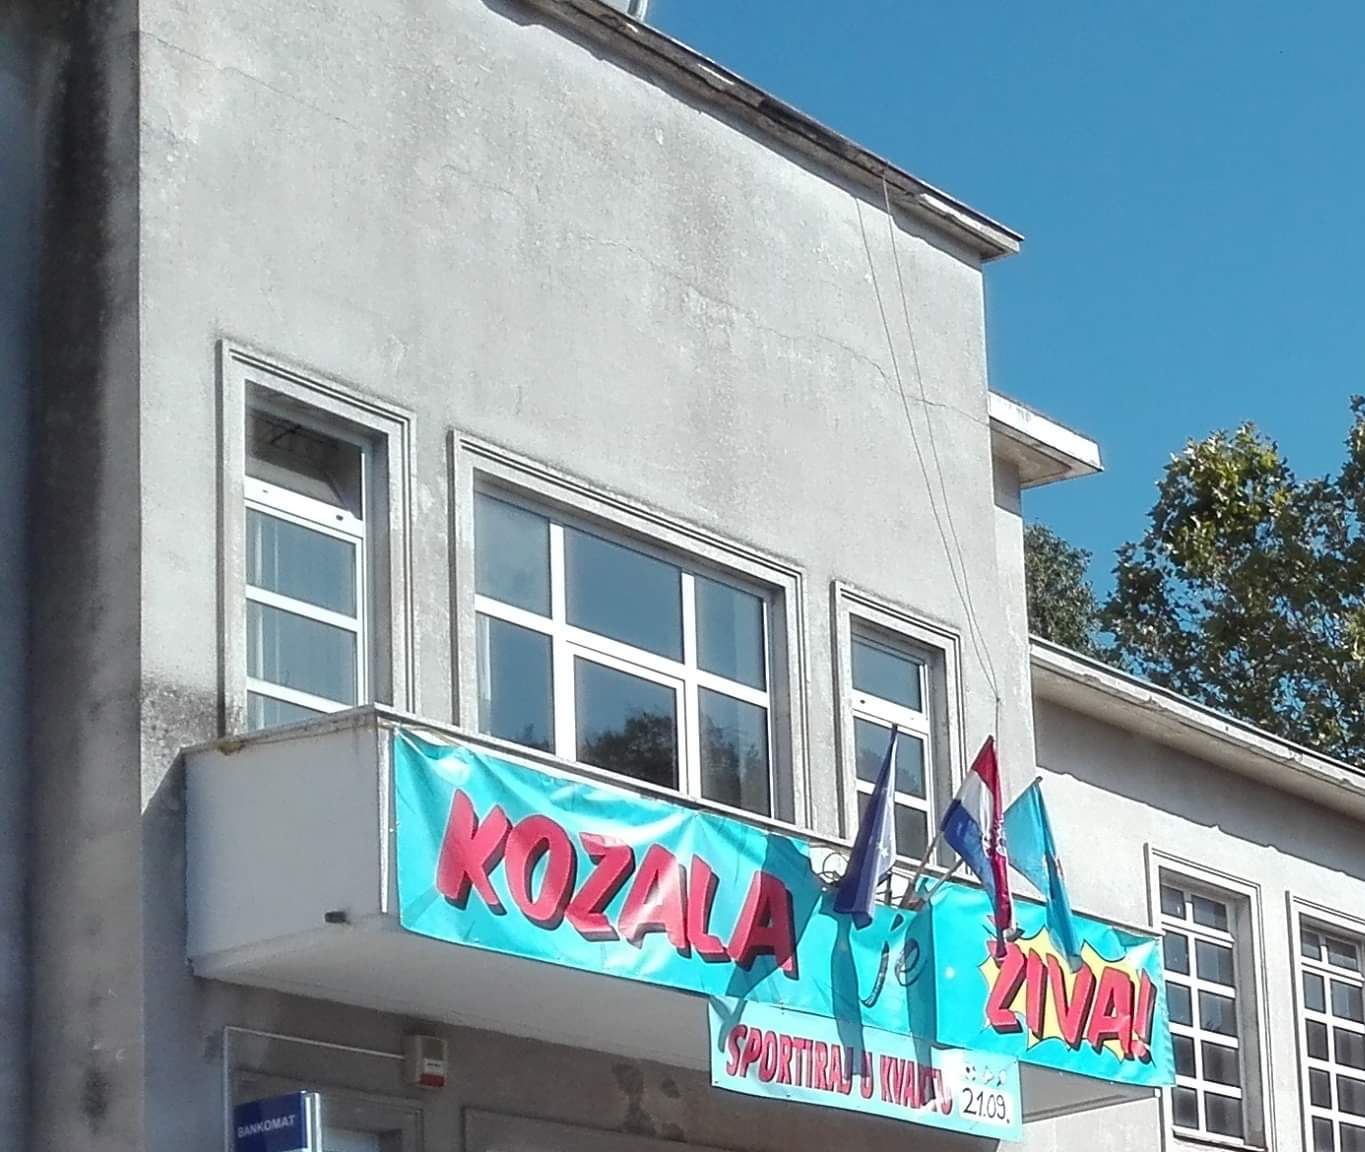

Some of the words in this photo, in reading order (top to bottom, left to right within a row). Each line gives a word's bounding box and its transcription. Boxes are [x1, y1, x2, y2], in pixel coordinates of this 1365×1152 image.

[436, 789, 799, 980] KOZALA
[726, 1024, 854, 1096] SPORTIRAJ
[237, 1114, 296, 1139] BANKOMAT
[961, 1087, 1011, 1124] 21.09.
